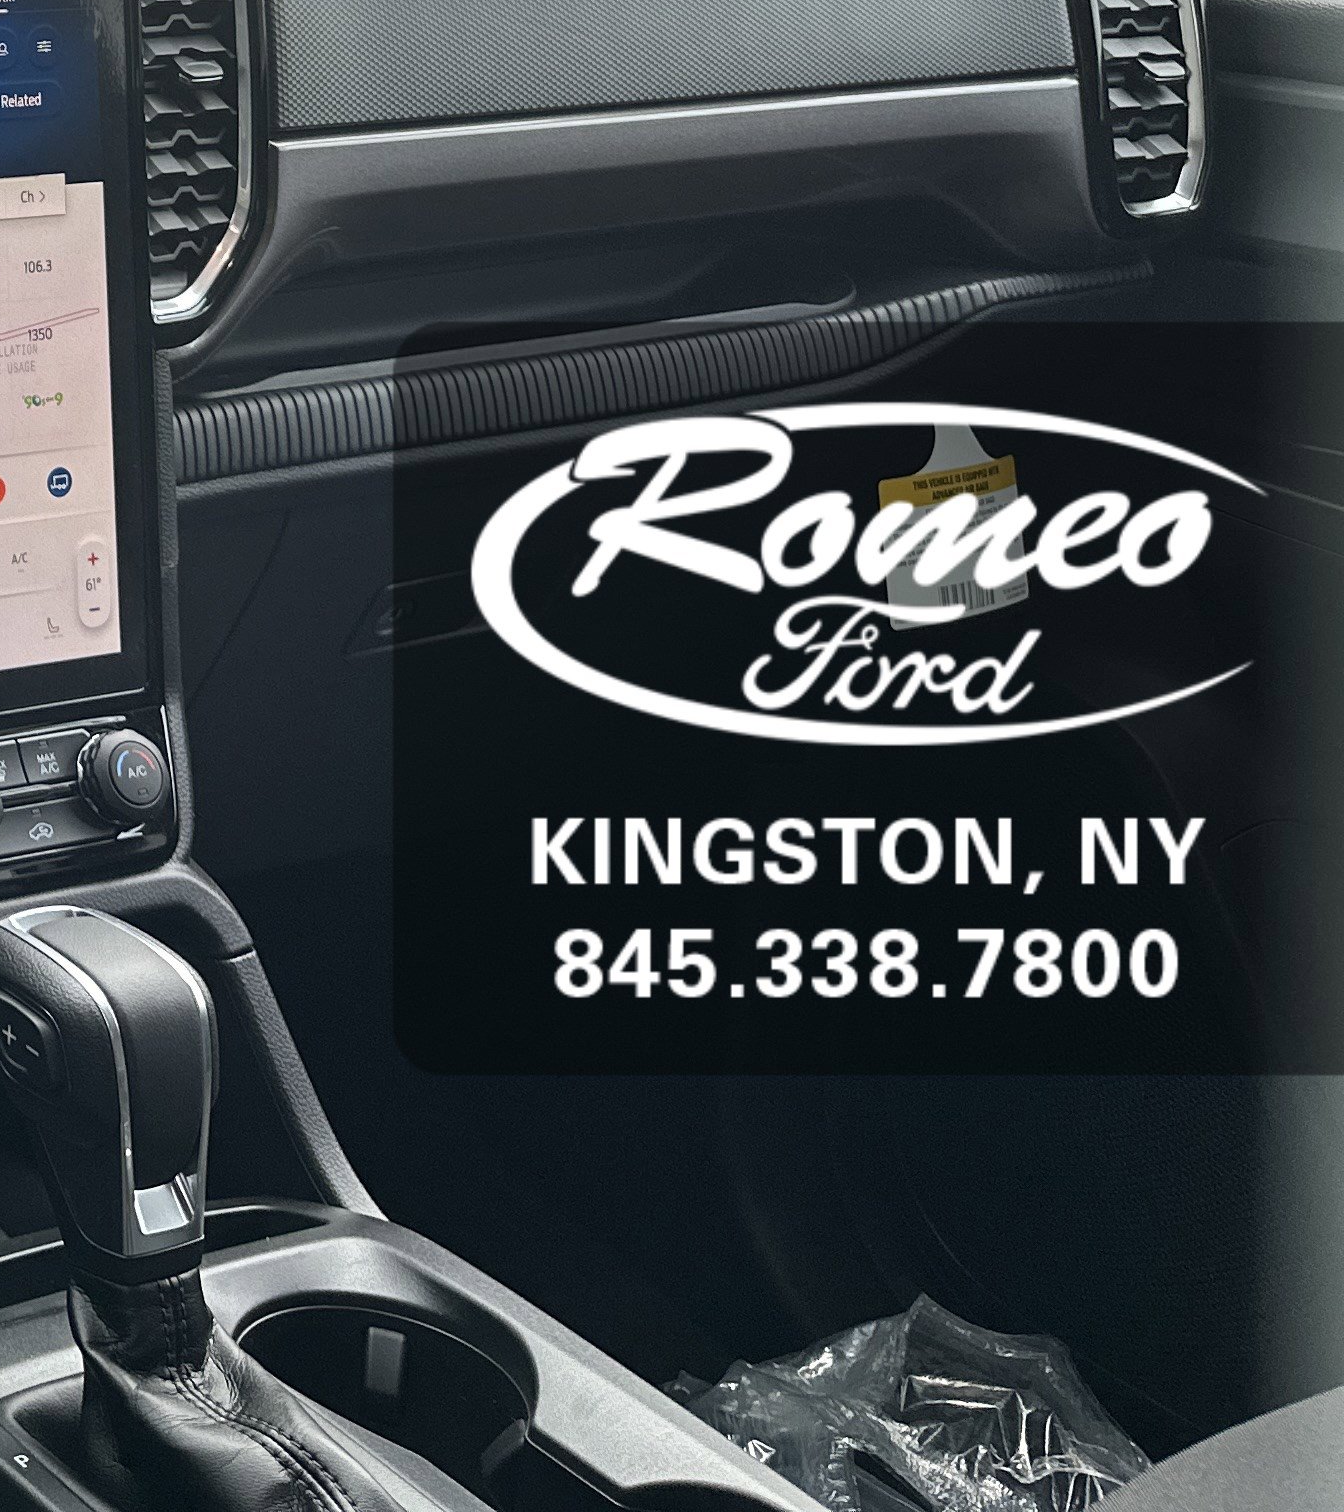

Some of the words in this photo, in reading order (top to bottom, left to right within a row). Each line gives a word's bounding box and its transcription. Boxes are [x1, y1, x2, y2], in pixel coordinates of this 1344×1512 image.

[0, 92, 42, 109] Related
[20, 190, 35, 204] Ch
[23, 259, 52, 274] 106.3
[27, 327, 53, 341] 1350
[7, 360, 36, 374] USAGE
[11, 550, 28, 565] A/C
[36, 751, 57, 763] MAX
[40, 762, 60, 775] A/C
[128, 764, 148, 779] A/C
[13, 1454, 30, 1468] P
